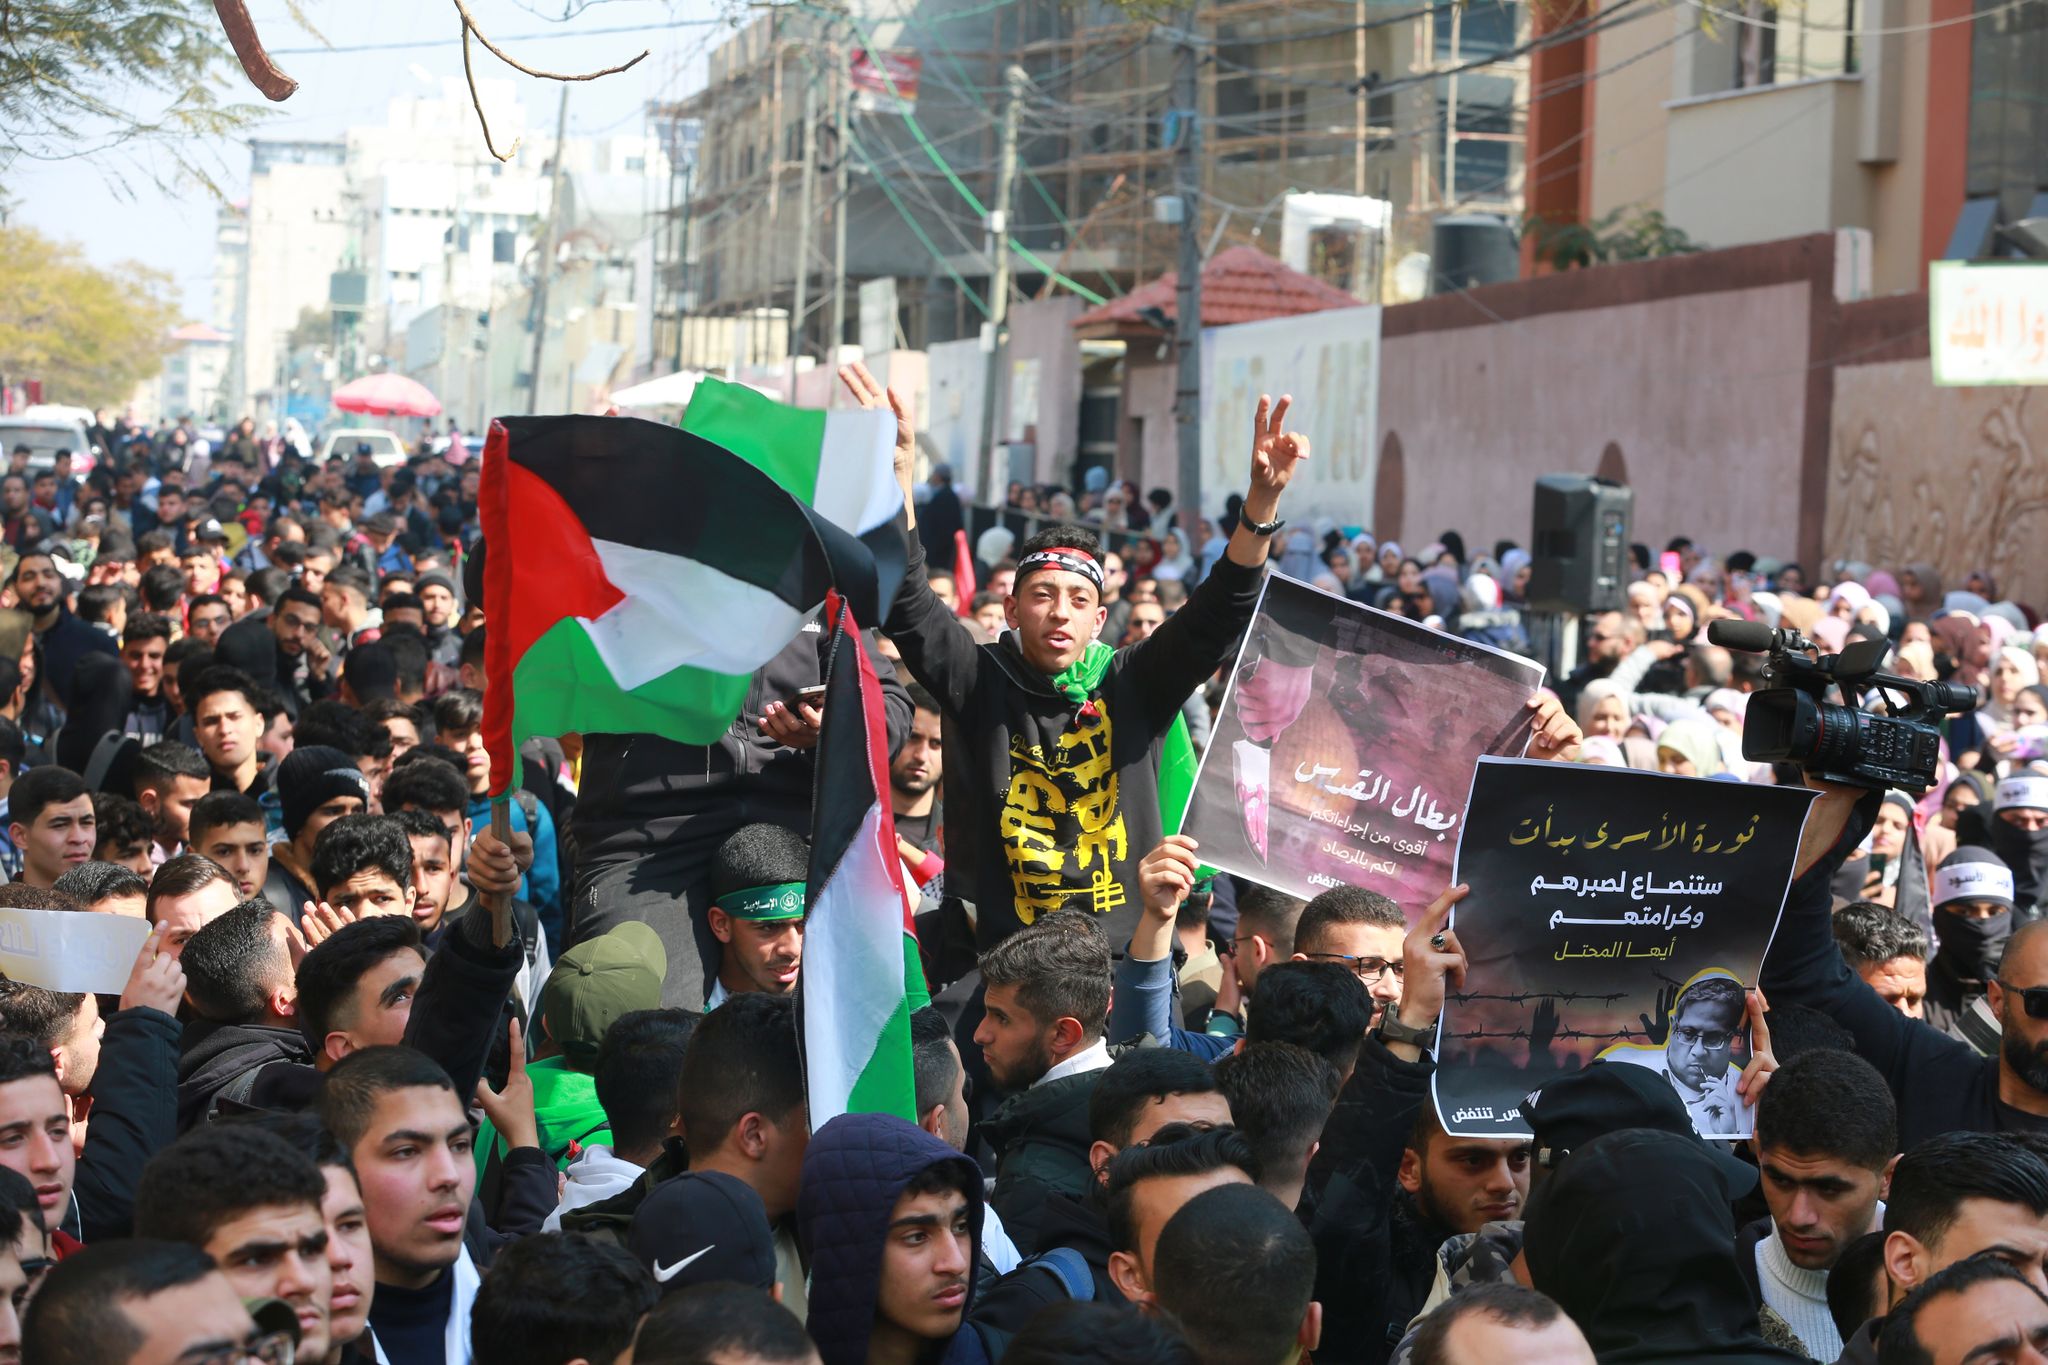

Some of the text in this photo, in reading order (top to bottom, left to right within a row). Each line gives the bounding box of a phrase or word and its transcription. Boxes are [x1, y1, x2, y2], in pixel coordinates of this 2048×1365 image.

[1294, 761, 1466, 841] بطال القدس
[1308, 808, 1429, 856] أقوى من إجراءاتكم
[1508, 804, 1576, 856] بدأت
[1582, 811, 1686, 850] الأسرى
[1322, 841, 1397, 875] لكم بالمرصاد
[1530, 871, 1723, 901] ستنصاع لصبرهم
[744, 897, 778, 912] الإسلامية
[1549, 905, 1704, 930] وكرامتهم
[1554, 937, 1676, 961] أيها المحتل
